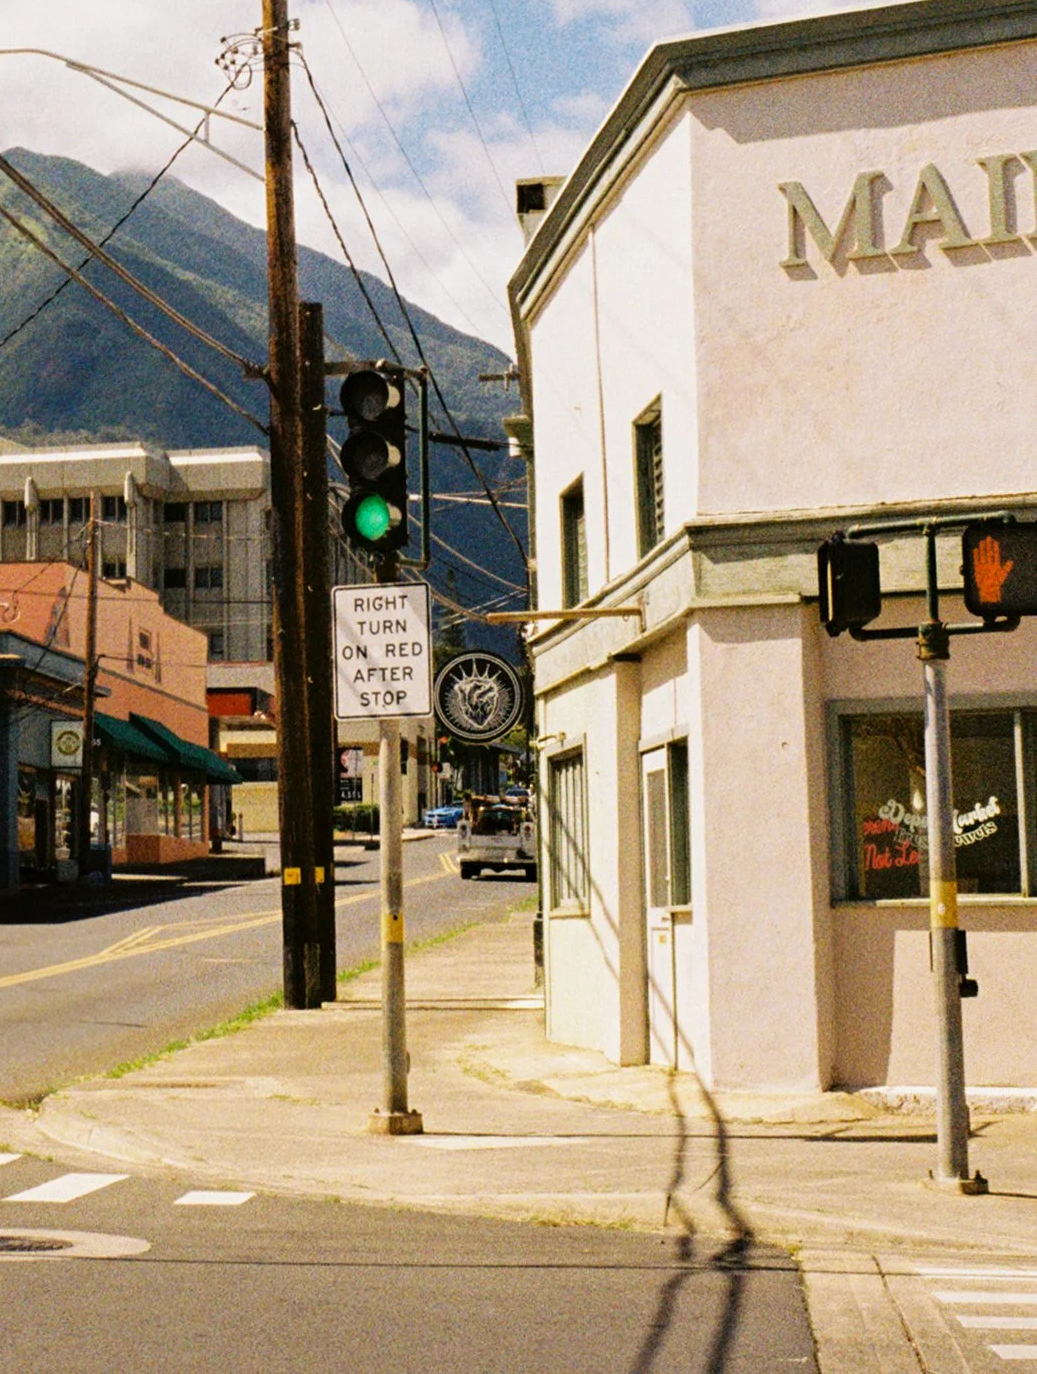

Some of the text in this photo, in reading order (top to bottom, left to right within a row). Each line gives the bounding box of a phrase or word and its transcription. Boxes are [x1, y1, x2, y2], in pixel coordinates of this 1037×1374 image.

[354, 594, 408, 612] RIGHT
[357, 619, 407, 635] TURN
[342, 642, 423, 660] ON RED
[353, 666, 413, 683] AFTER
[360, 690, 407, 707] STOP
